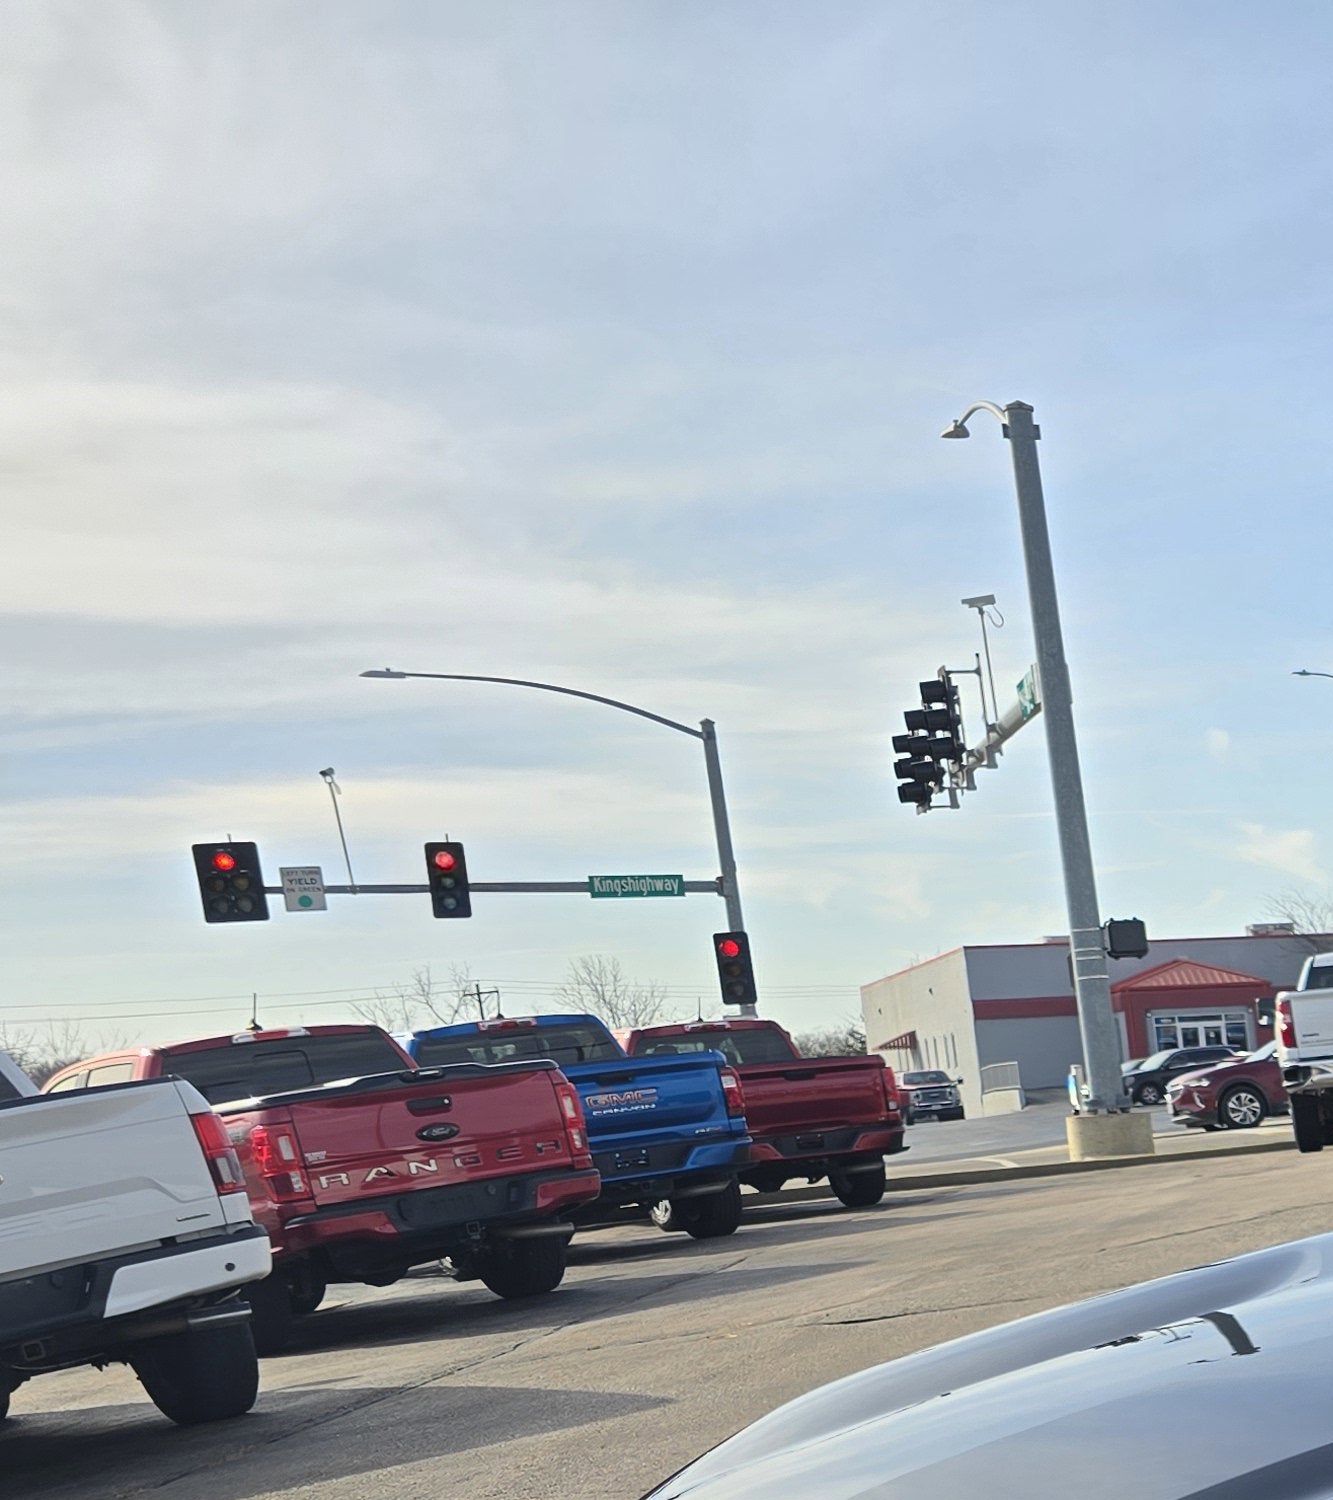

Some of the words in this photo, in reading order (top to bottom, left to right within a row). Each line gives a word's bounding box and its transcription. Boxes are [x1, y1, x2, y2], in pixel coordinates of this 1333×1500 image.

[593, 877, 679, 896] Kingshighway
[585, 1088, 658, 1108] GMC
[319, 1140, 562, 1189] RANGER
